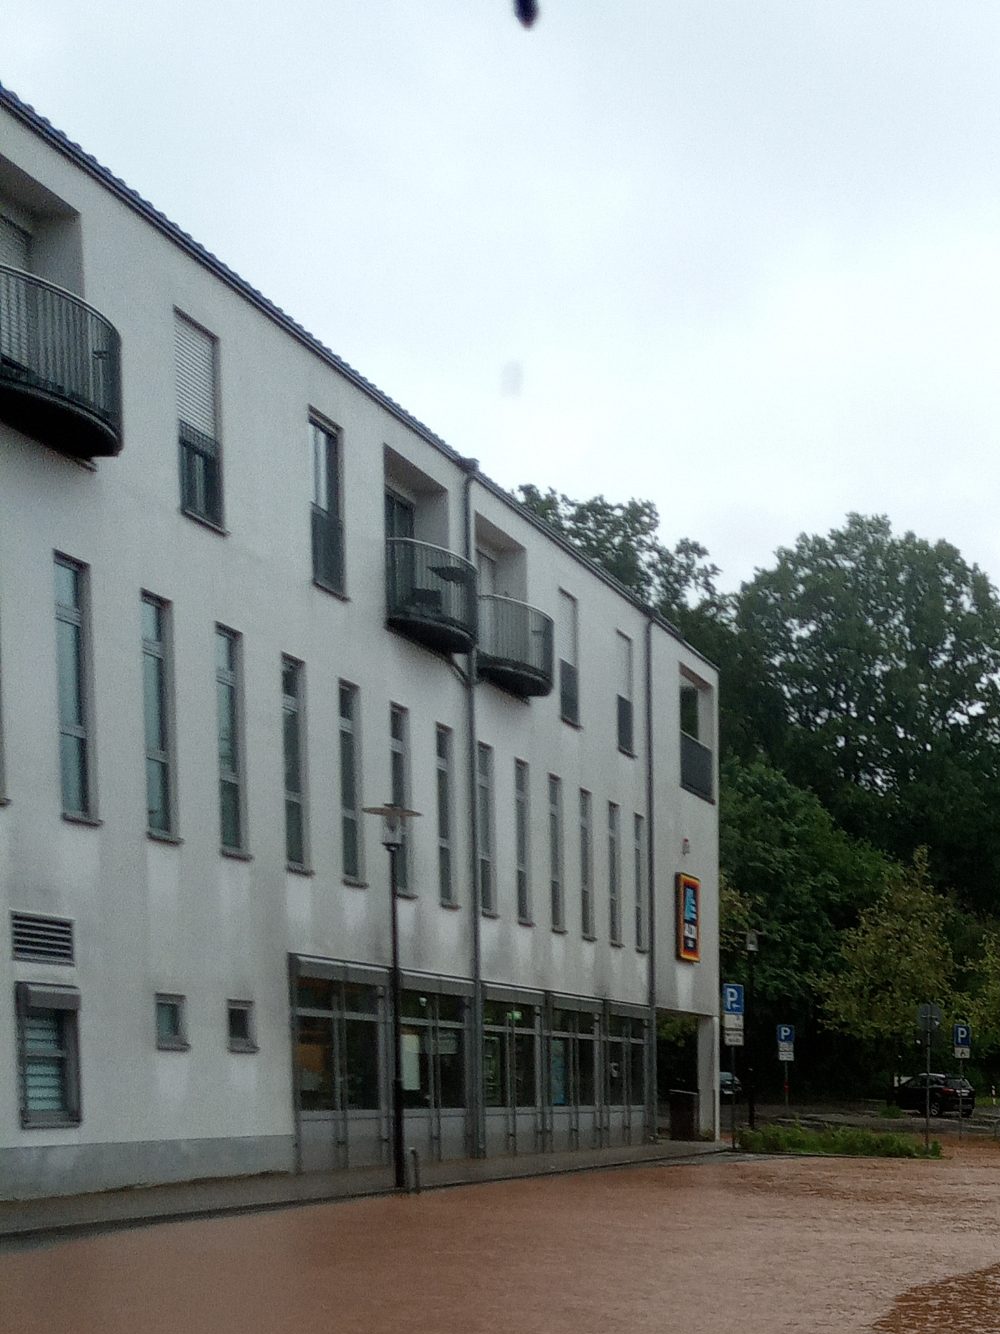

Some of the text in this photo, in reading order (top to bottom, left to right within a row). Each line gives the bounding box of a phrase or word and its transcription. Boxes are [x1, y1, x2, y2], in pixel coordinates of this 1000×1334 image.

[726, 987, 738, 1010] P
[780, 1027, 791, 1040] P
[957, 1027, 968, 1044] P
